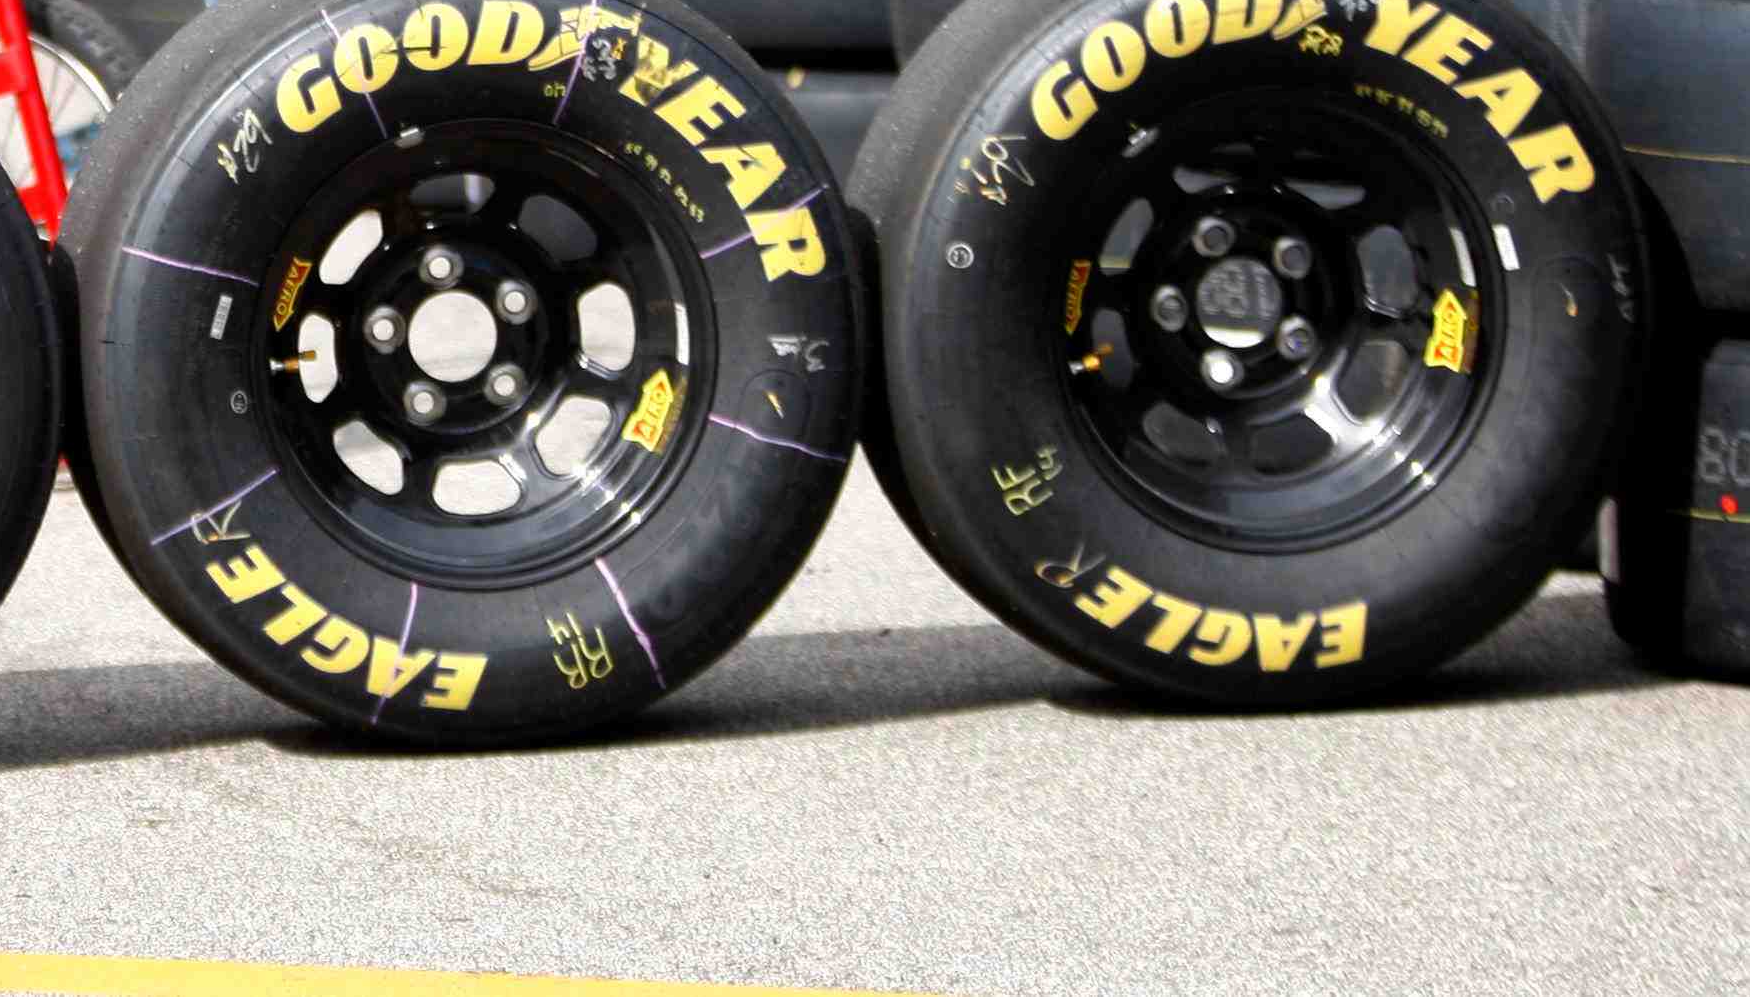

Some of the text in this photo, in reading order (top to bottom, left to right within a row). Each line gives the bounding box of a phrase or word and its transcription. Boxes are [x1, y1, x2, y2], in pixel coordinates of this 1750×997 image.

[206, 545, 489, 711] EAGLE
[553, 626, 613, 690] RR
[1075, 566, 1369, 672] EAGLE
